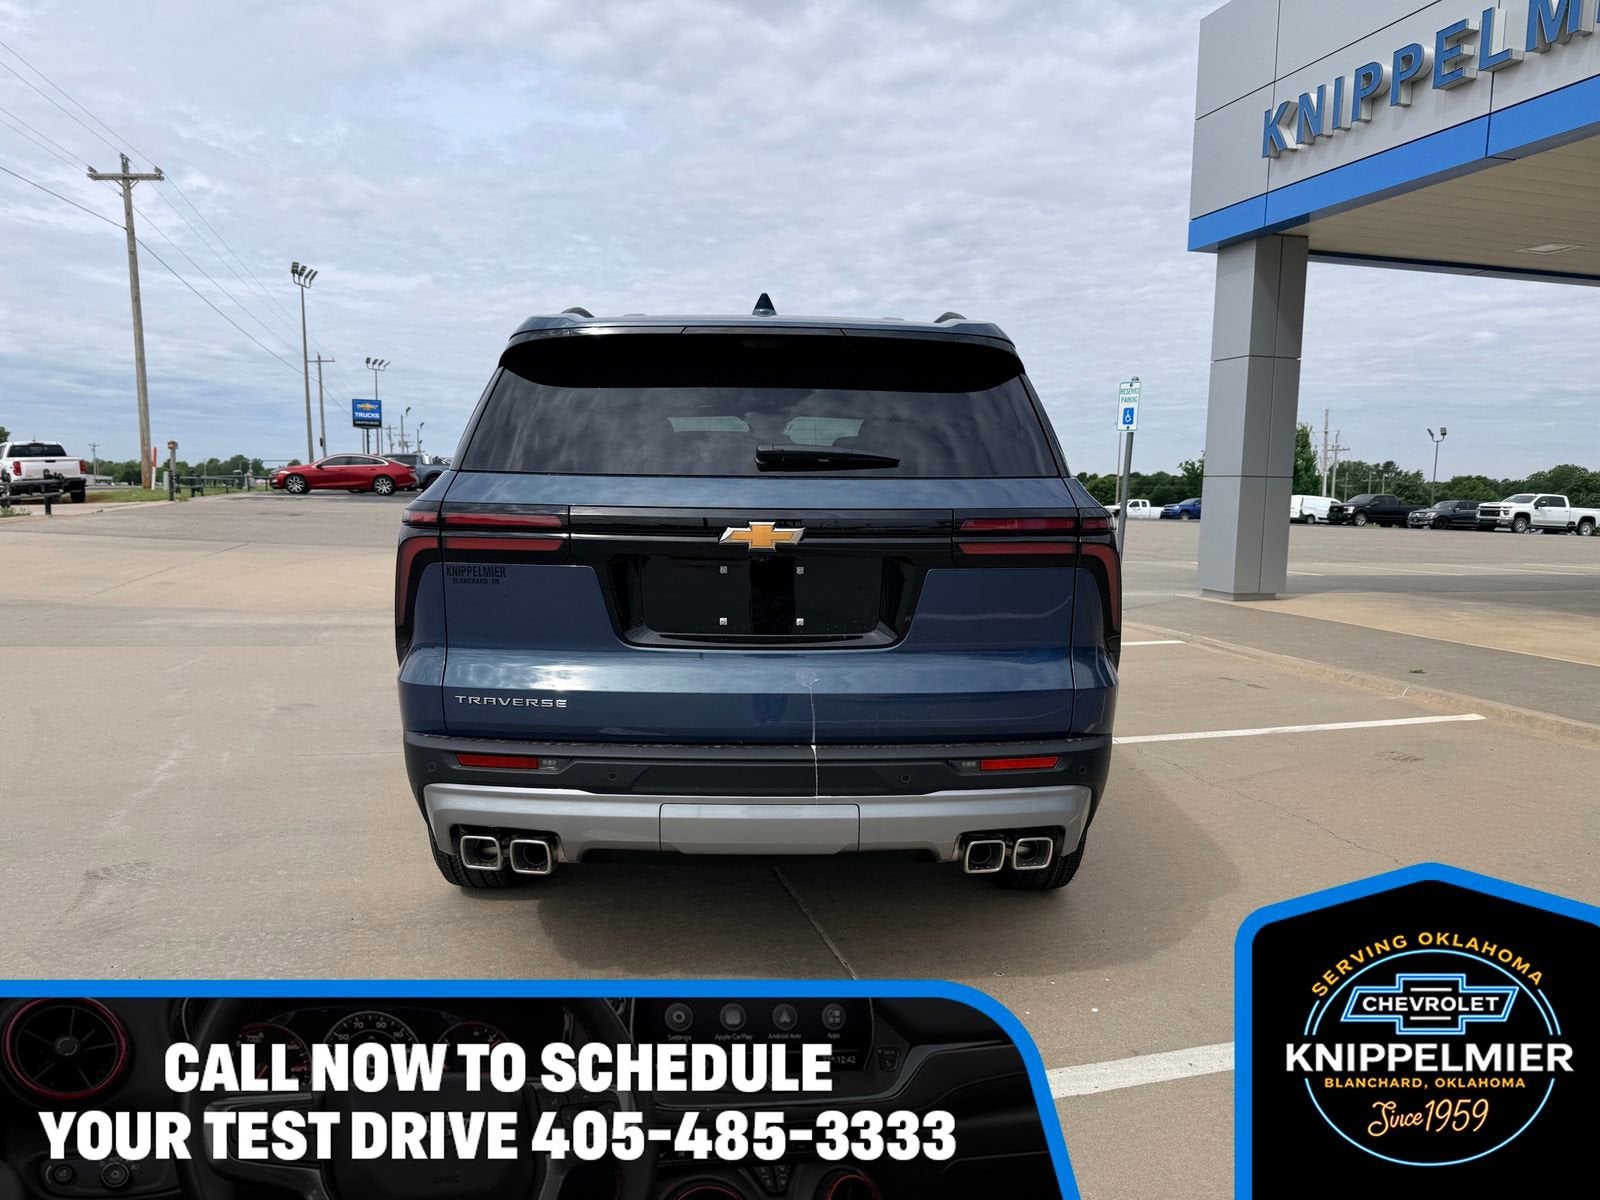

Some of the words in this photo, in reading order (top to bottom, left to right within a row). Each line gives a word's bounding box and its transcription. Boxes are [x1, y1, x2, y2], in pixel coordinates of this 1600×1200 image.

[1262, 0, 1600, 158] KNIPPELM
[446, 565, 506, 578] KNIPPELMIER
[455, 695, 567, 708] TRAVERSE
